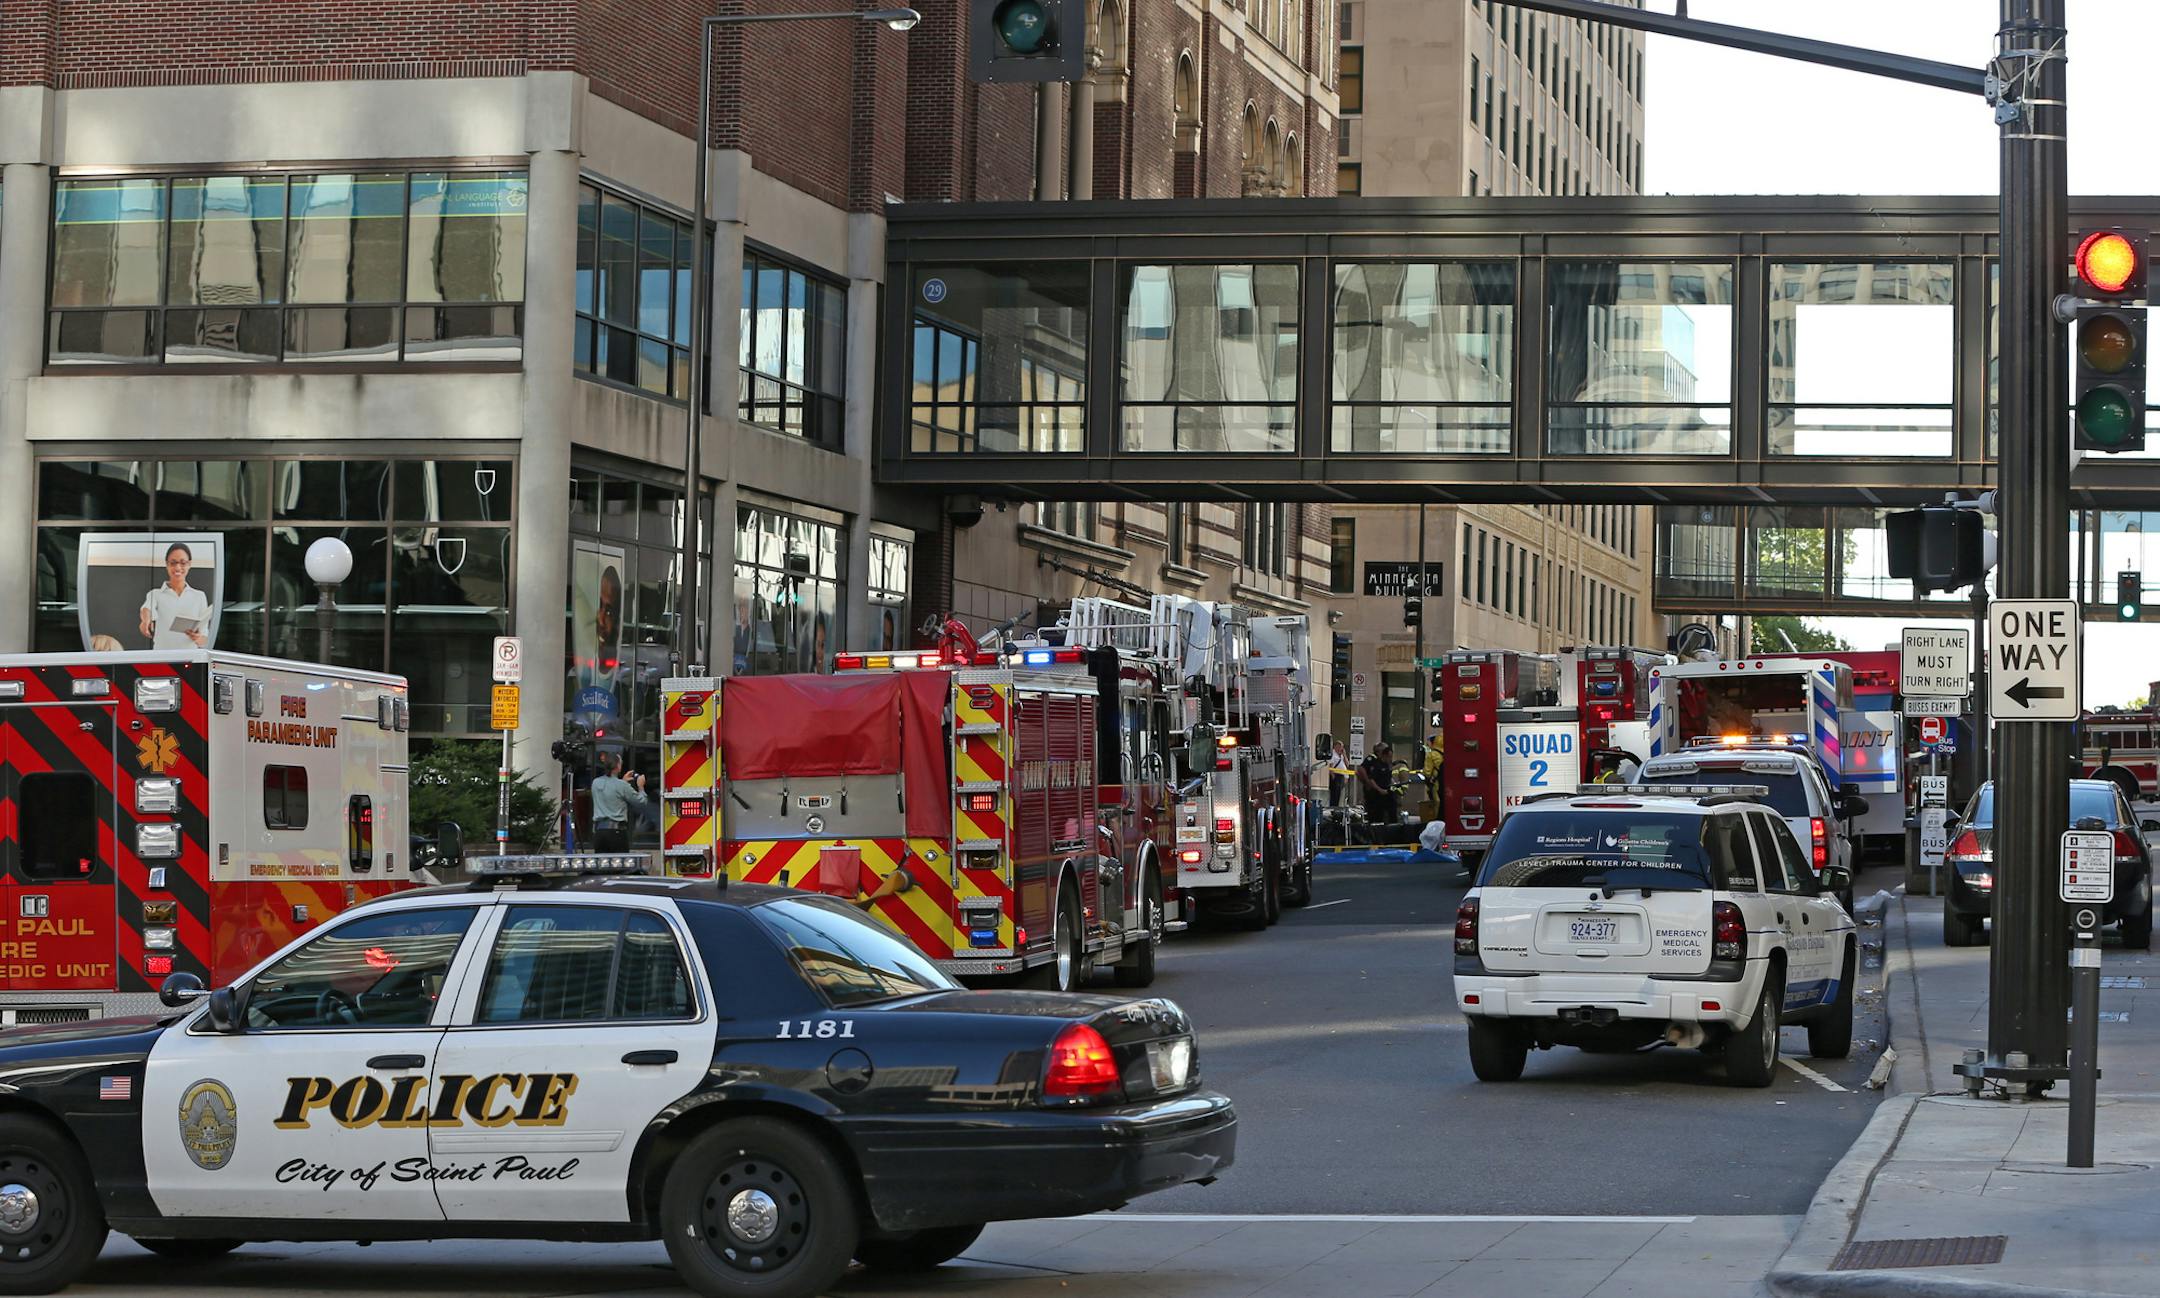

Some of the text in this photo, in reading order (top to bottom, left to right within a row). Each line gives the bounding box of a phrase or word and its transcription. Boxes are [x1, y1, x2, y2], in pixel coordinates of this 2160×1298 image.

[926, 284, 942, 298] 29
[1375, 585, 1432, 597] BUILG
[2000, 611, 2067, 639] ONE
[1906, 636, 1965, 649] RIGHT LANE
[1917, 655, 1953, 669] MUST
[2000, 644, 2068, 671] WAY
[1905, 675, 1965, 688] TURN RIGHT
[280, 694, 307, 719] FIRE
[1907, 701, 1957, 713] BUSES EXEMPT
[247, 719, 338, 749] PARAMEDIC UNIT
[1938, 736, 1954, 745] Bus
[1505, 733, 1573, 758] SQUAD
[1938, 745, 1957, 754] Stop
[1529, 760, 1549, 787] 2
[1922, 780, 1946, 789] BUS
[1922, 839, 1946, 848] BUS
[250, 864, 340, 877] EMERGENCY MEDICAL SERVICES
[1519, 860, 1544, 868] LEVEL
[1551, 859, 1585, 867] TRAUMA
[1621, 860, 1639, 868] FOR
[1641, 861, 1683, 870] CHILDREN
[17, 918, 95, 936] PAUL
[1570, 923, 1616, 937] 924-377
[1655, 929, 1708, 937] EMERGENCY
[1662, 939, 1700, 947] MEDICAL
[1661, 948, 1702, 957] SERVICES
[56, 963, 110, 977] UNIT
[775, 1019, 856, 1039] 1181
[273, 1073, 580, 1129] POLICE
[275, 1155, 580, 1192] City of Saint Paul
